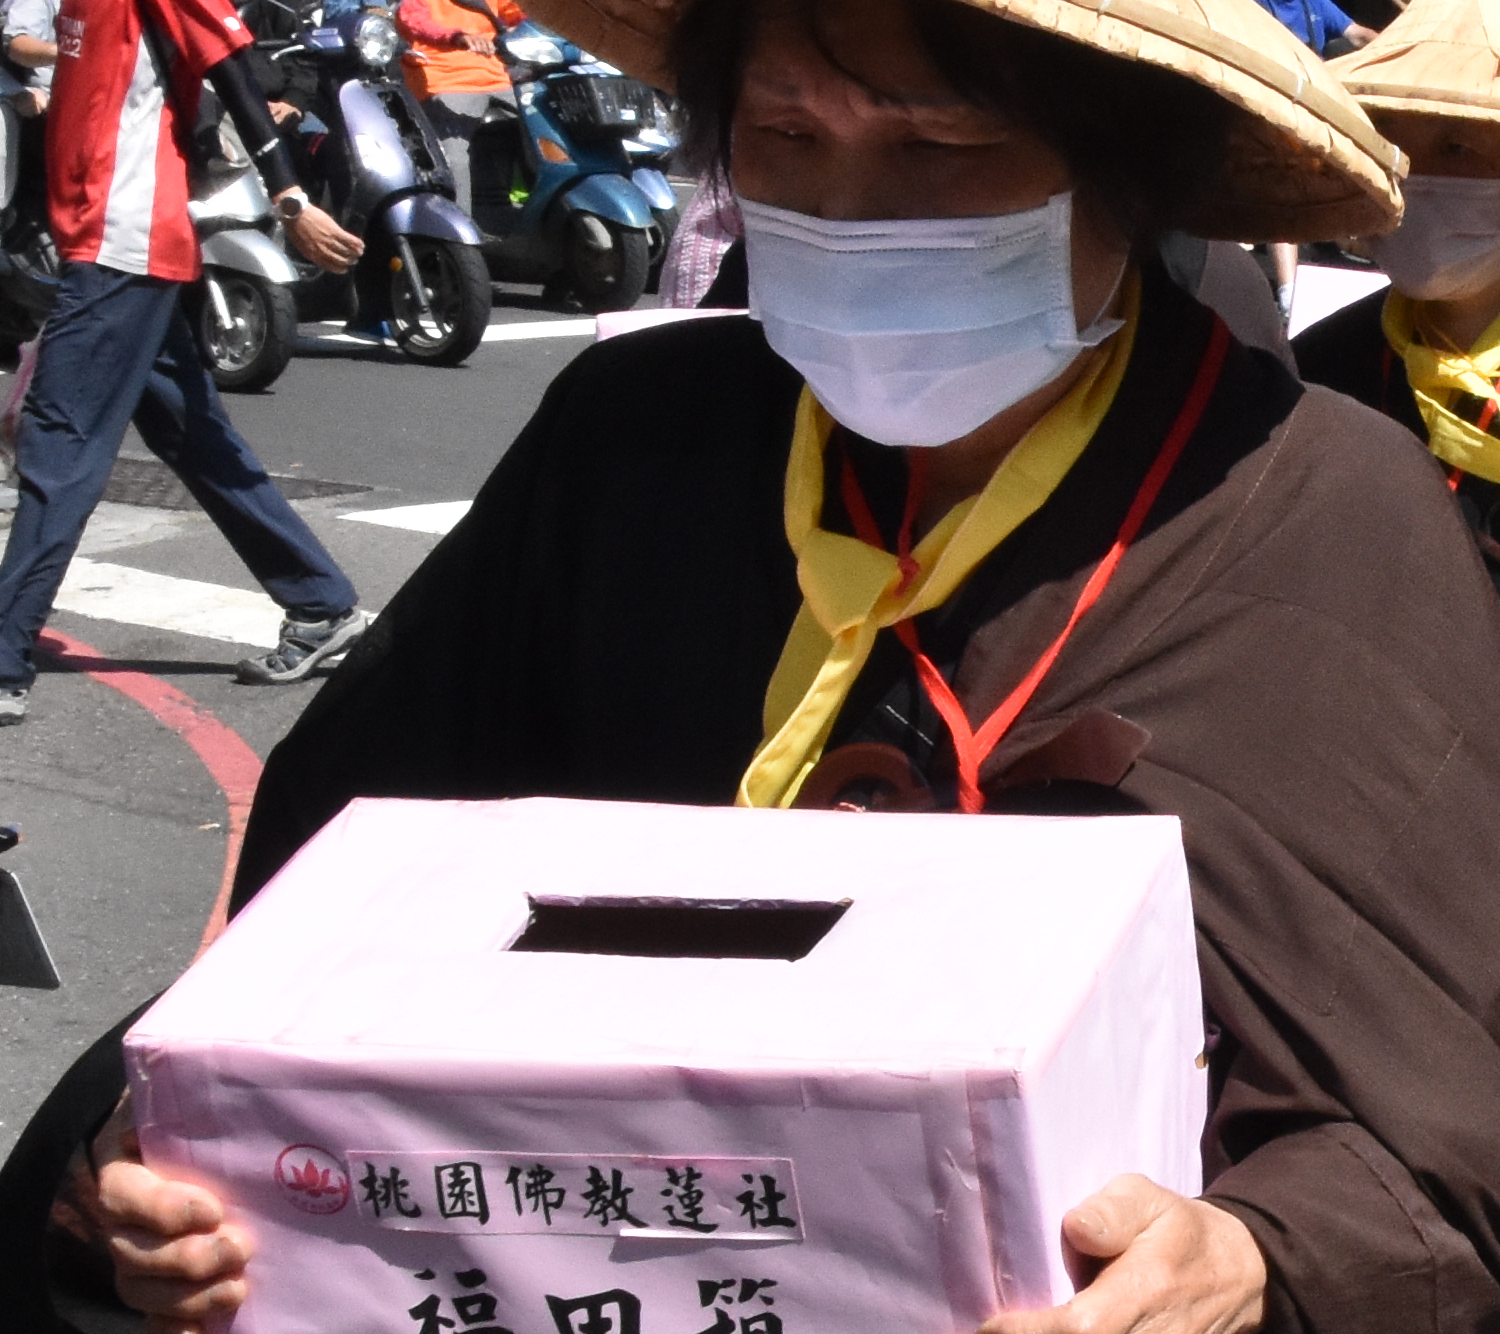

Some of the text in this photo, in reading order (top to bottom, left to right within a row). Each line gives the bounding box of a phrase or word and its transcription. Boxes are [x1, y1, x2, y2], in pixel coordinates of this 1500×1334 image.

[358, 1160, 800, 1233] 桃園佛教蓮社
